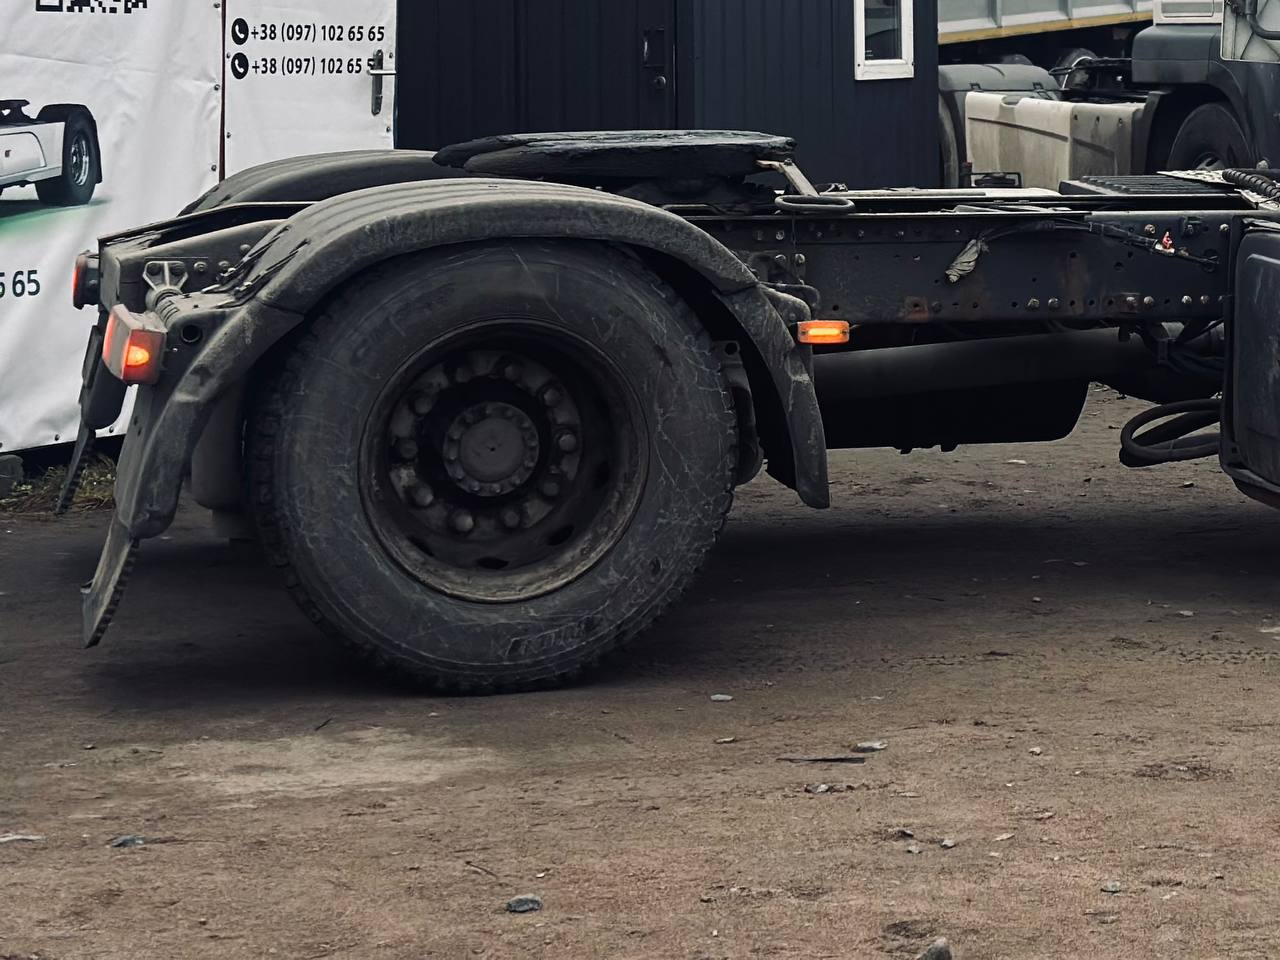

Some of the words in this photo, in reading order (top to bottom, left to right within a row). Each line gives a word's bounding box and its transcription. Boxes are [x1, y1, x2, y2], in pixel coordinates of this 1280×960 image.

[251, 23, 277, 41] +38
[281, 22, 316, 43] (097)
[321, 25, 344, 41] 102
[348, 25, 364, 41] 65
[367, 25, 385, 41] 65
[251, 57, 277, 74] +38
[281, 56, 316, 76] (097)
[320, 57, 343, 74] 102
[346, 57, 362, 74] 65
[12, 269, 41, 298] 65
